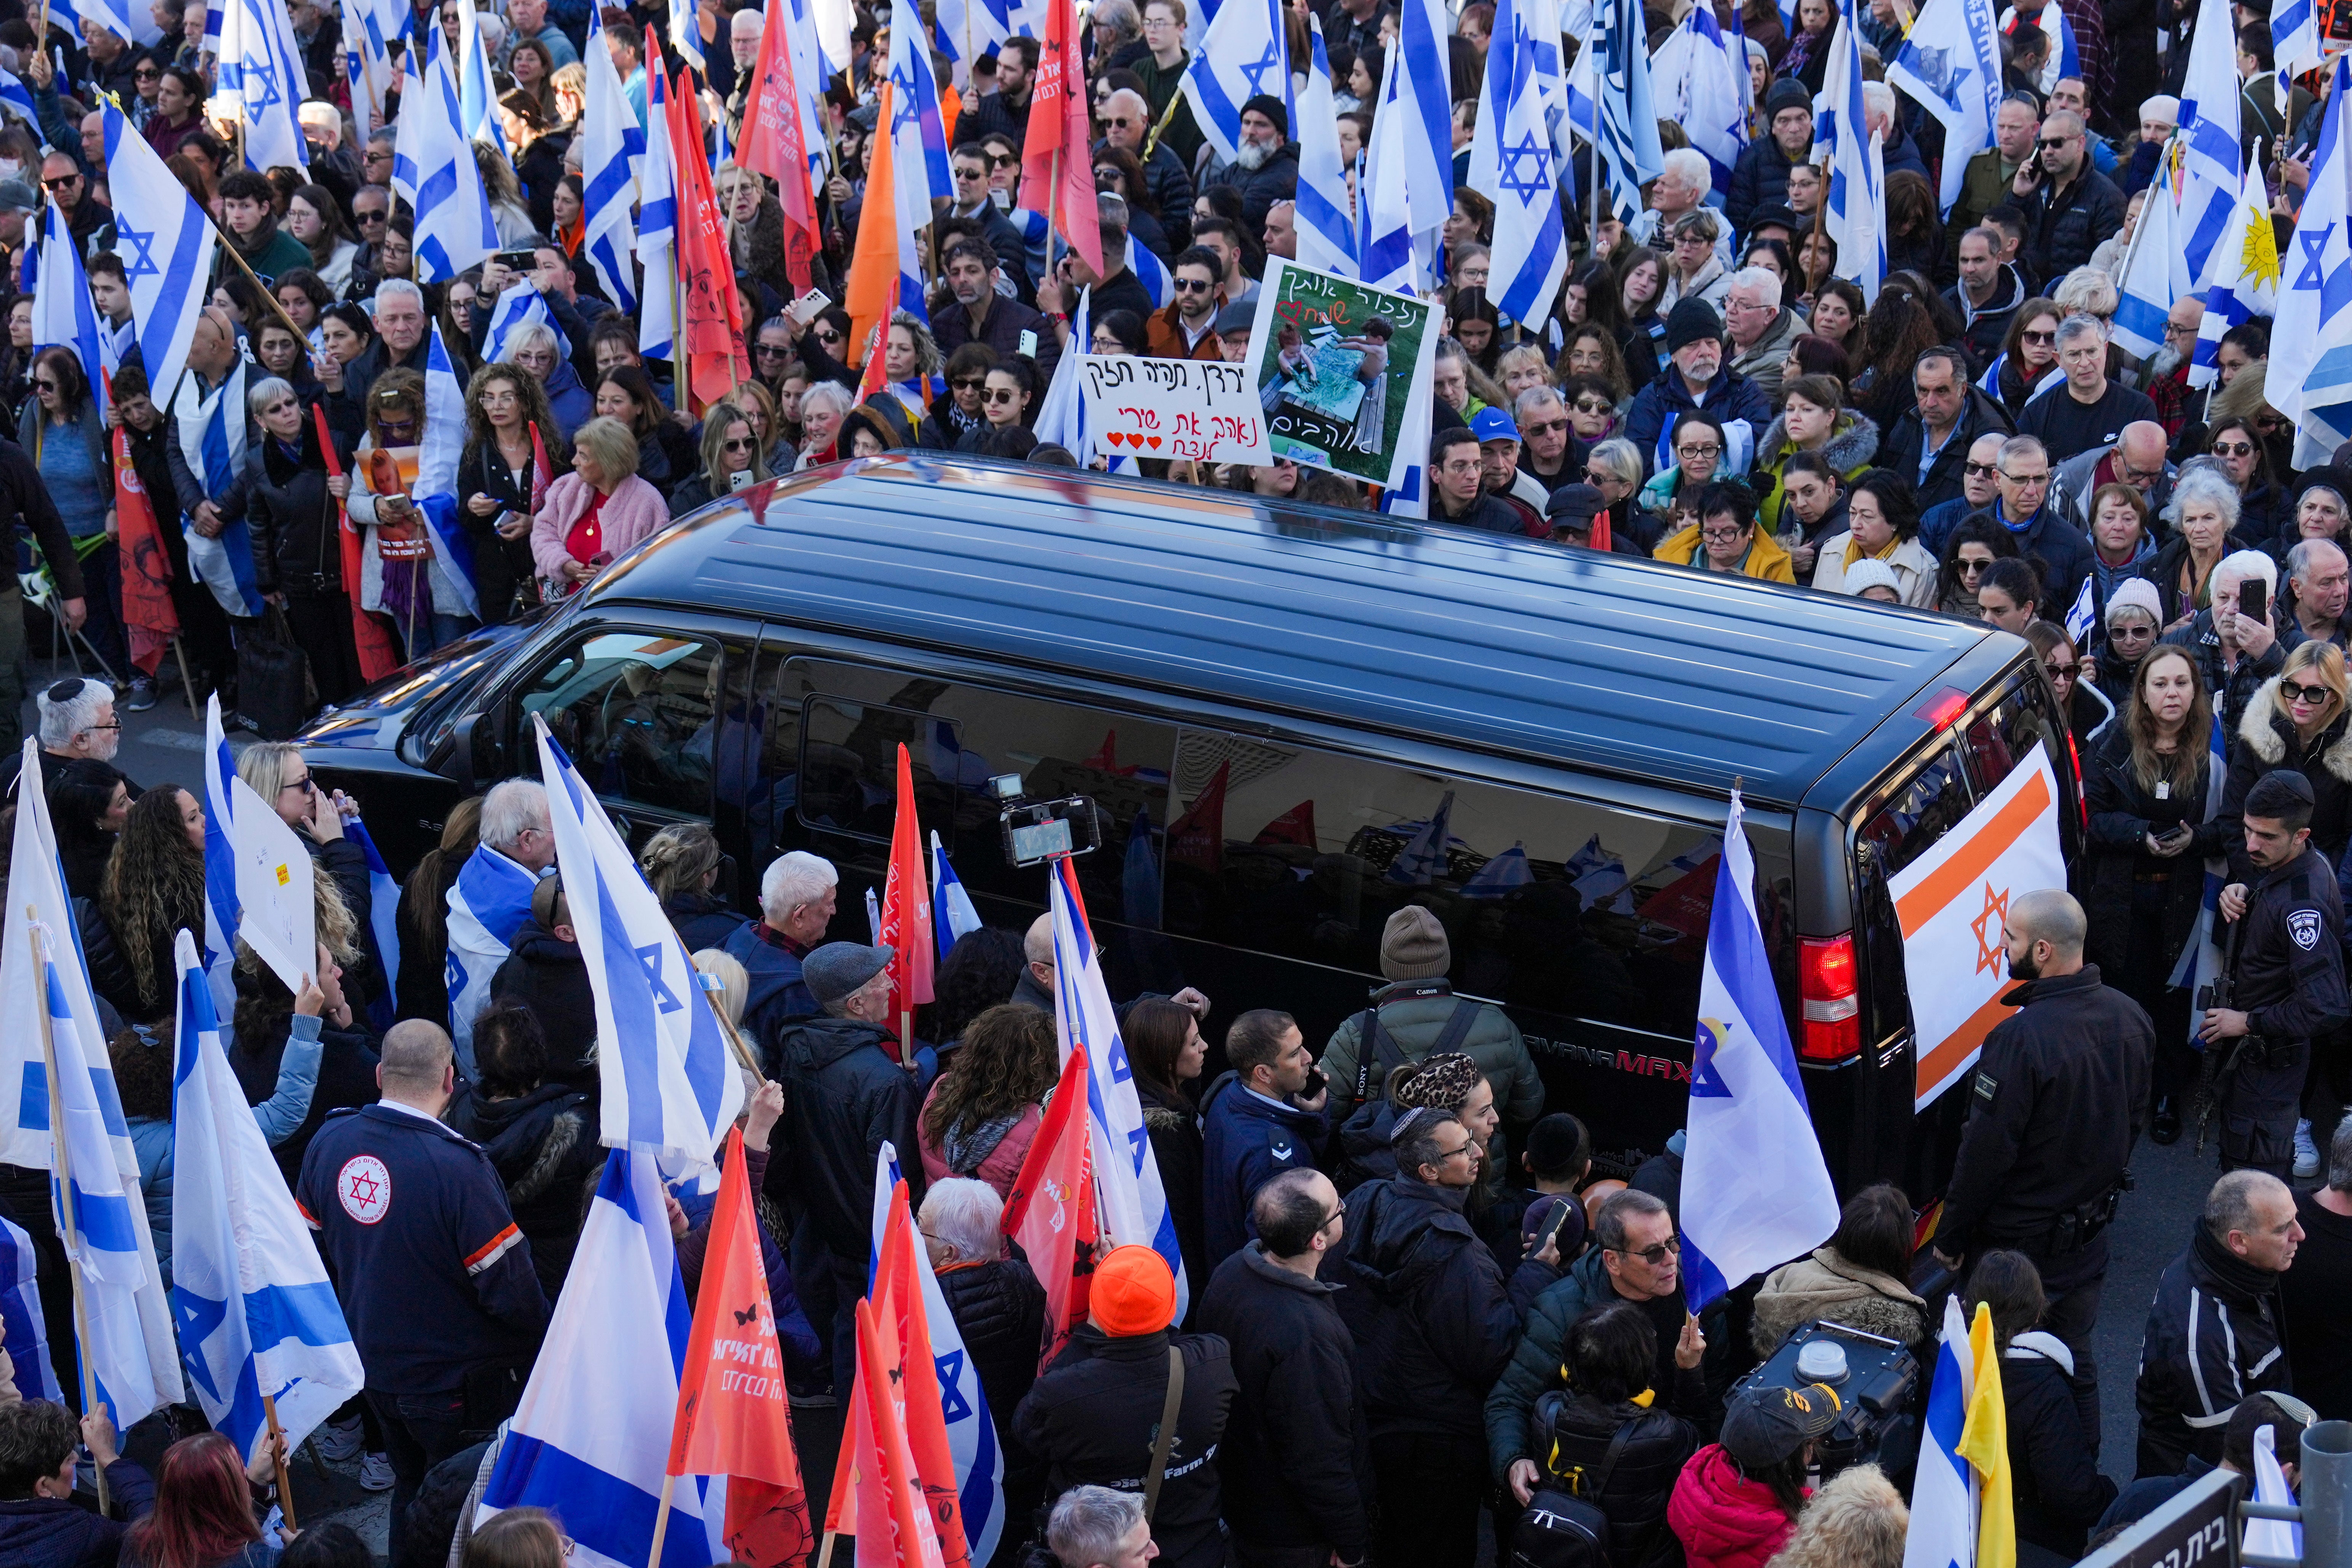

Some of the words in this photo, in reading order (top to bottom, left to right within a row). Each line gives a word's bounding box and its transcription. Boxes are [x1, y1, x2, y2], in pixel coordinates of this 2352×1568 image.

[1285, 271, 1336, 303] אותך
[1304, 300, 1351, 325] שמח
[1356, 291, 1417, 328] נזכור
[1086, 360, 1134, 399] חזק
[1142, 360, 1187, 392] תהיה
[1118, 407, 1160, 429] שירי
[1172, 411, 1202, 436] את
[1211, 416, 1257, 447] נאהב
[1172, 439, 1219, 461] לנצח
[1268, 416, 1373, 454] אוהבים
[1358, 1065, 1367, 1095] SONY
[341, 1159, 361, 1178] בישראל
[363, 1158, 378, 1167] אדום
[378, 1166, 386, 1176] דוד
[340, 1186, 348, 1206] MAGEN
[347, 1206, 360, 1219] DAVID
[379, 1198, 388, 1215] ISRAEL
[1164, 1457, 1203, 1479] Farm
[2184, 1515, 2226, 1568] בית
